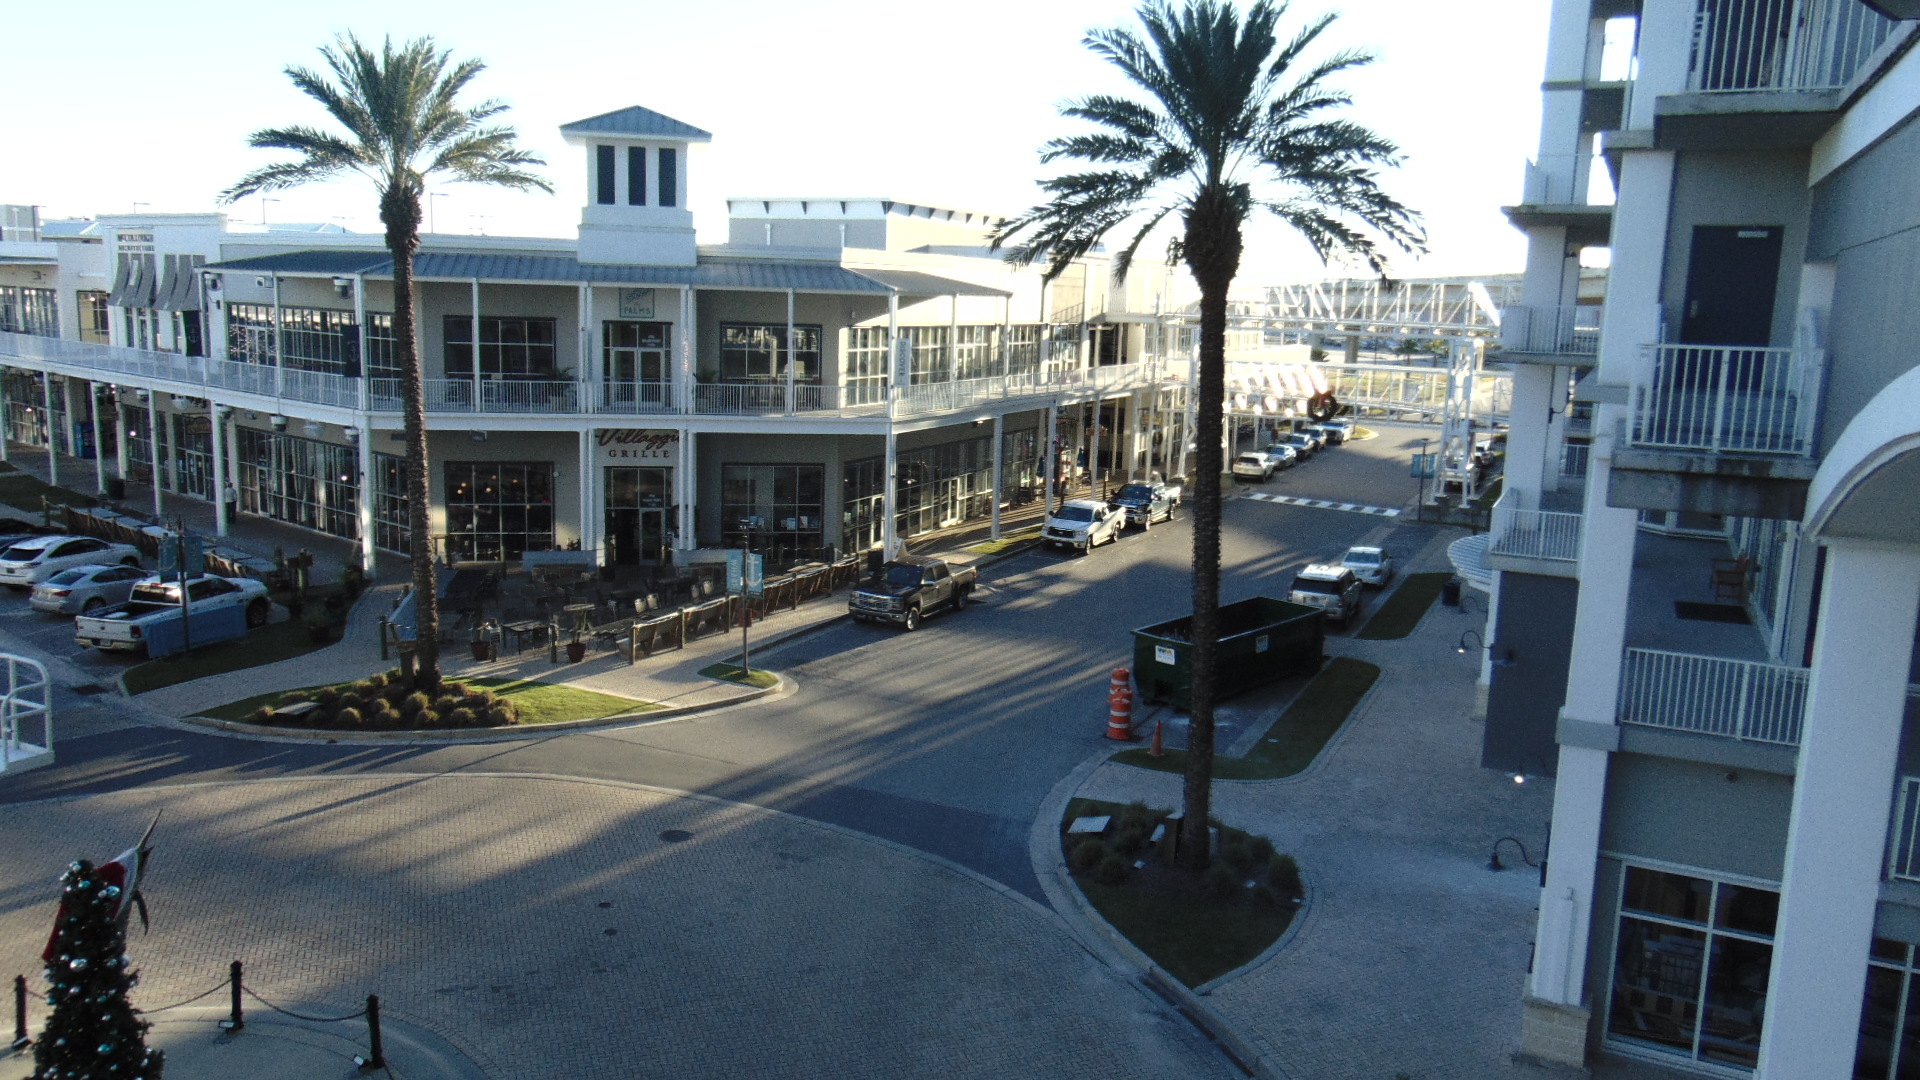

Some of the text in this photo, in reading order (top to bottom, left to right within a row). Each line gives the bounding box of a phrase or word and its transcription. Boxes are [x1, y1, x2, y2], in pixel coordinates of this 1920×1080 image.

[898, 341, 906, 377] DISCOVER
[595, 429, 679, 450] Villaggi
[608, 450, 669, 458] GRILLE
